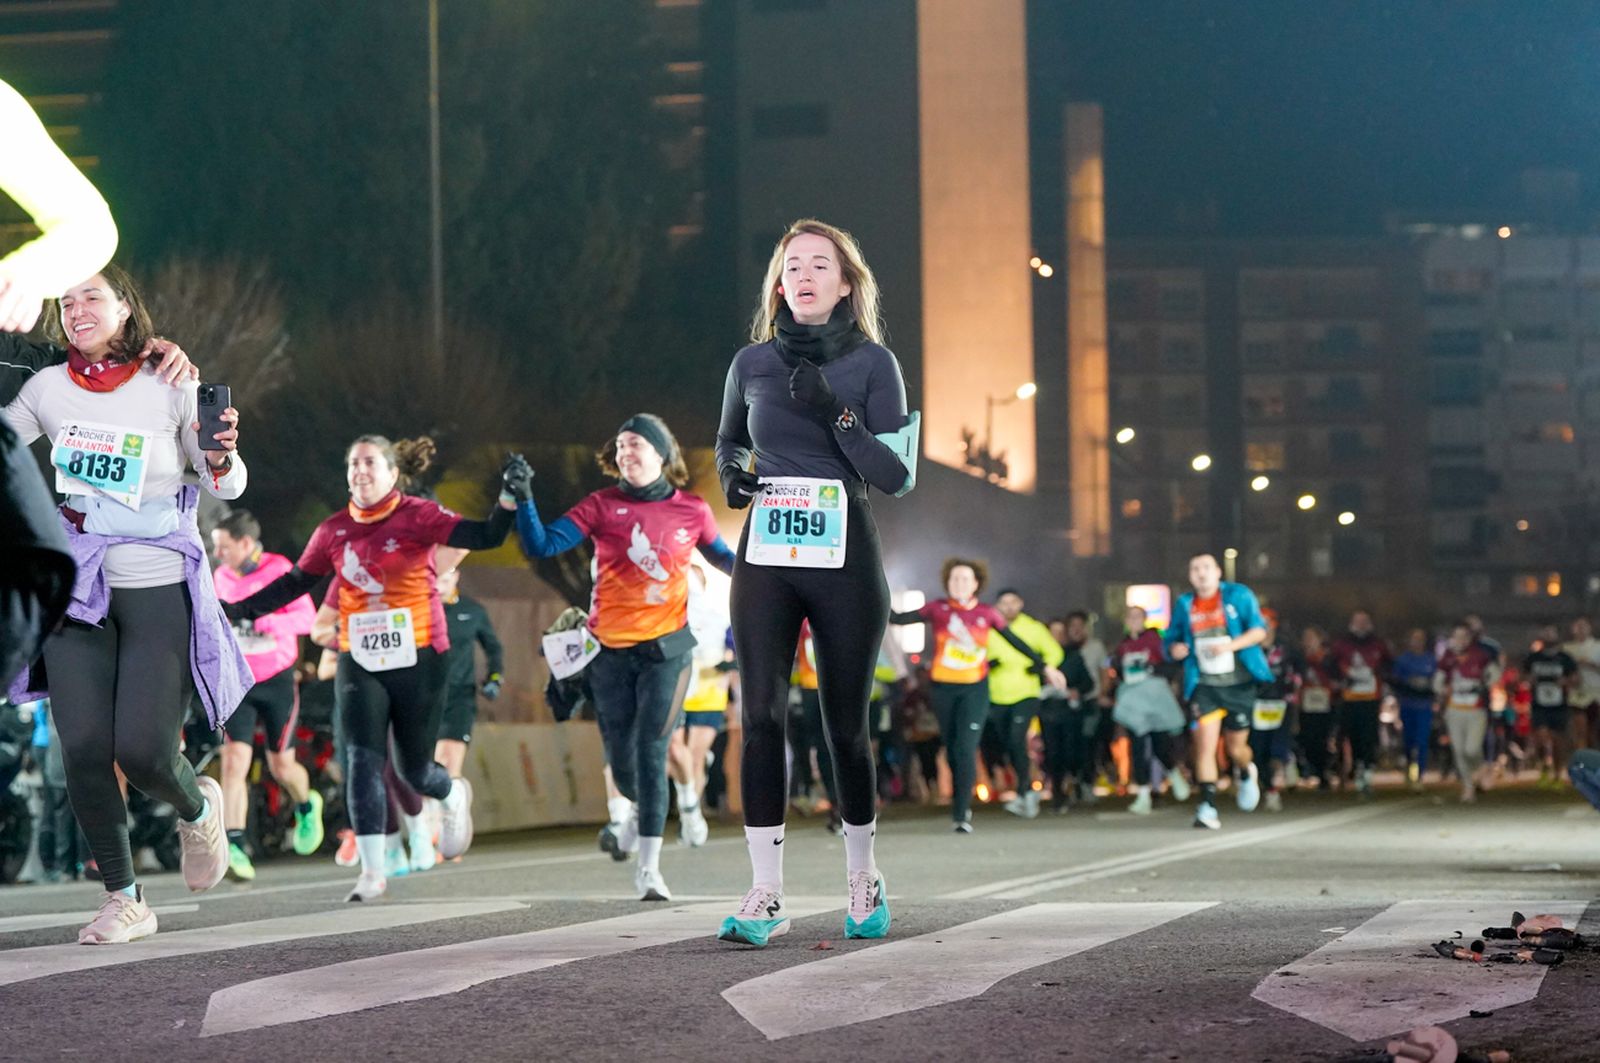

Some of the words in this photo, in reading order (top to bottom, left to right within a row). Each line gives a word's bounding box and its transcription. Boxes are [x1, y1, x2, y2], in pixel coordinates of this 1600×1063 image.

[77, 430, 105, 442] NOCHE
[105, 434, 116, 443] DE
[64, 438, 83, 449] SAN
[68, 450, 127, 482] 8133
[774, 487, 798, 496] NOCHE
[799, 487, 811, 497] DE
[763, 497, 779, 507] SAN
[768, 509, 826, 537] 8159
[786, 537, 803, 545] ALBA
[361, 631, 402, 651] 4289
